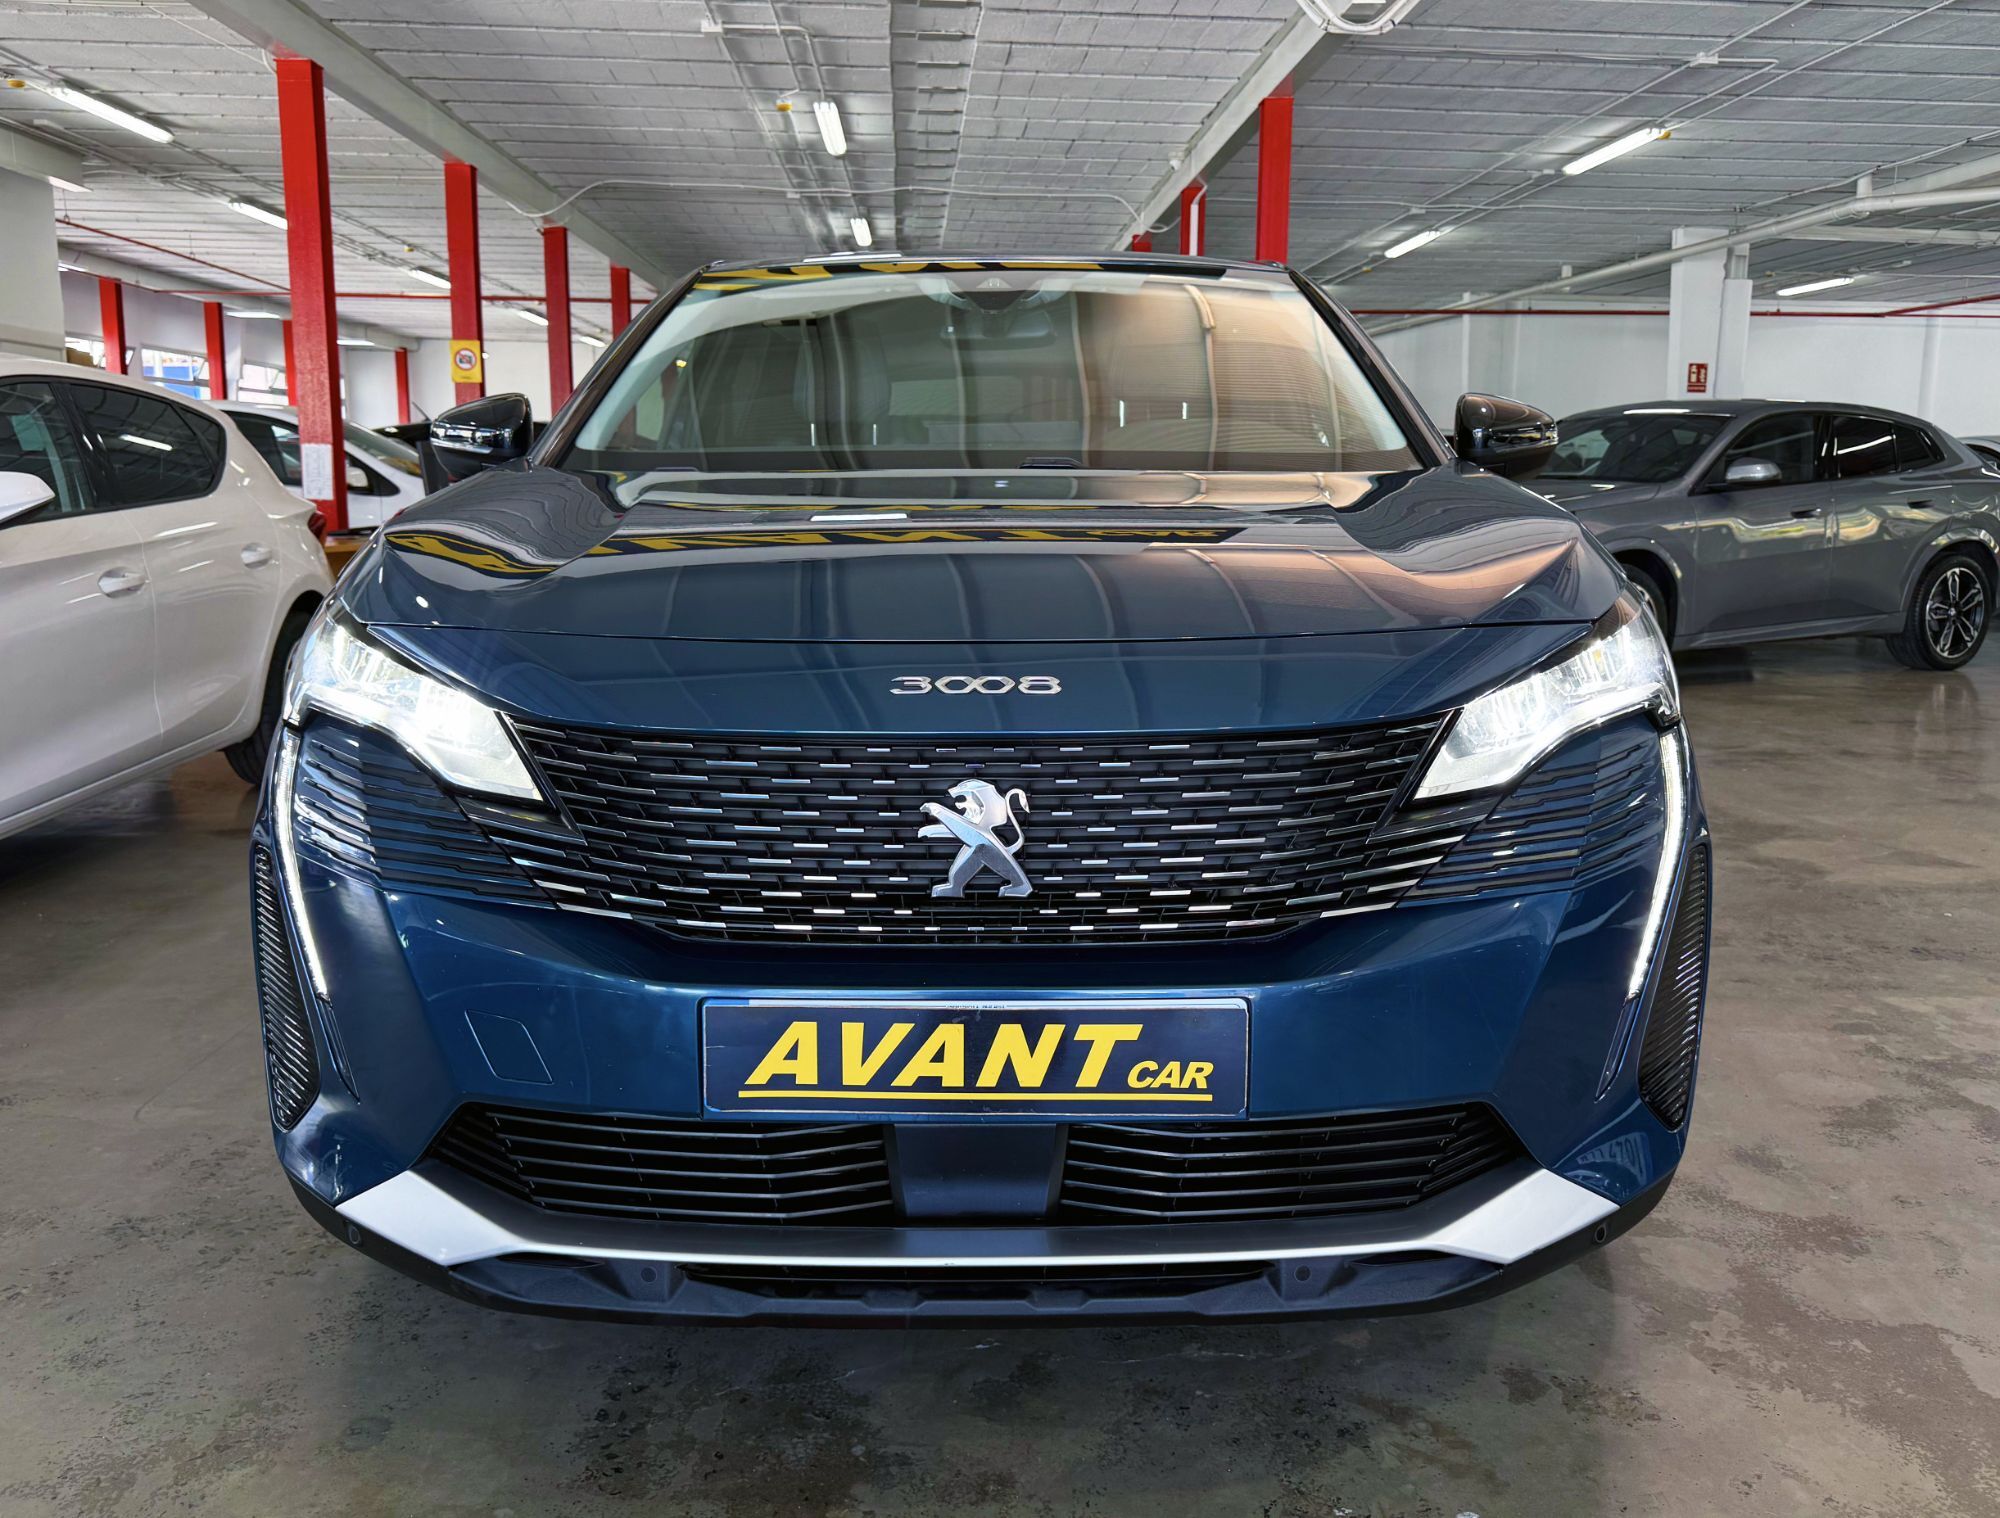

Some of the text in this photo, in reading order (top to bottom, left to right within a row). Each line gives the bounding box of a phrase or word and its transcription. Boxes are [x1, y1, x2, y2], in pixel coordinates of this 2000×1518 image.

[889, 675, 1063, 695] 3008
[744, 1021, 1214, 1089] AVANT CAR
